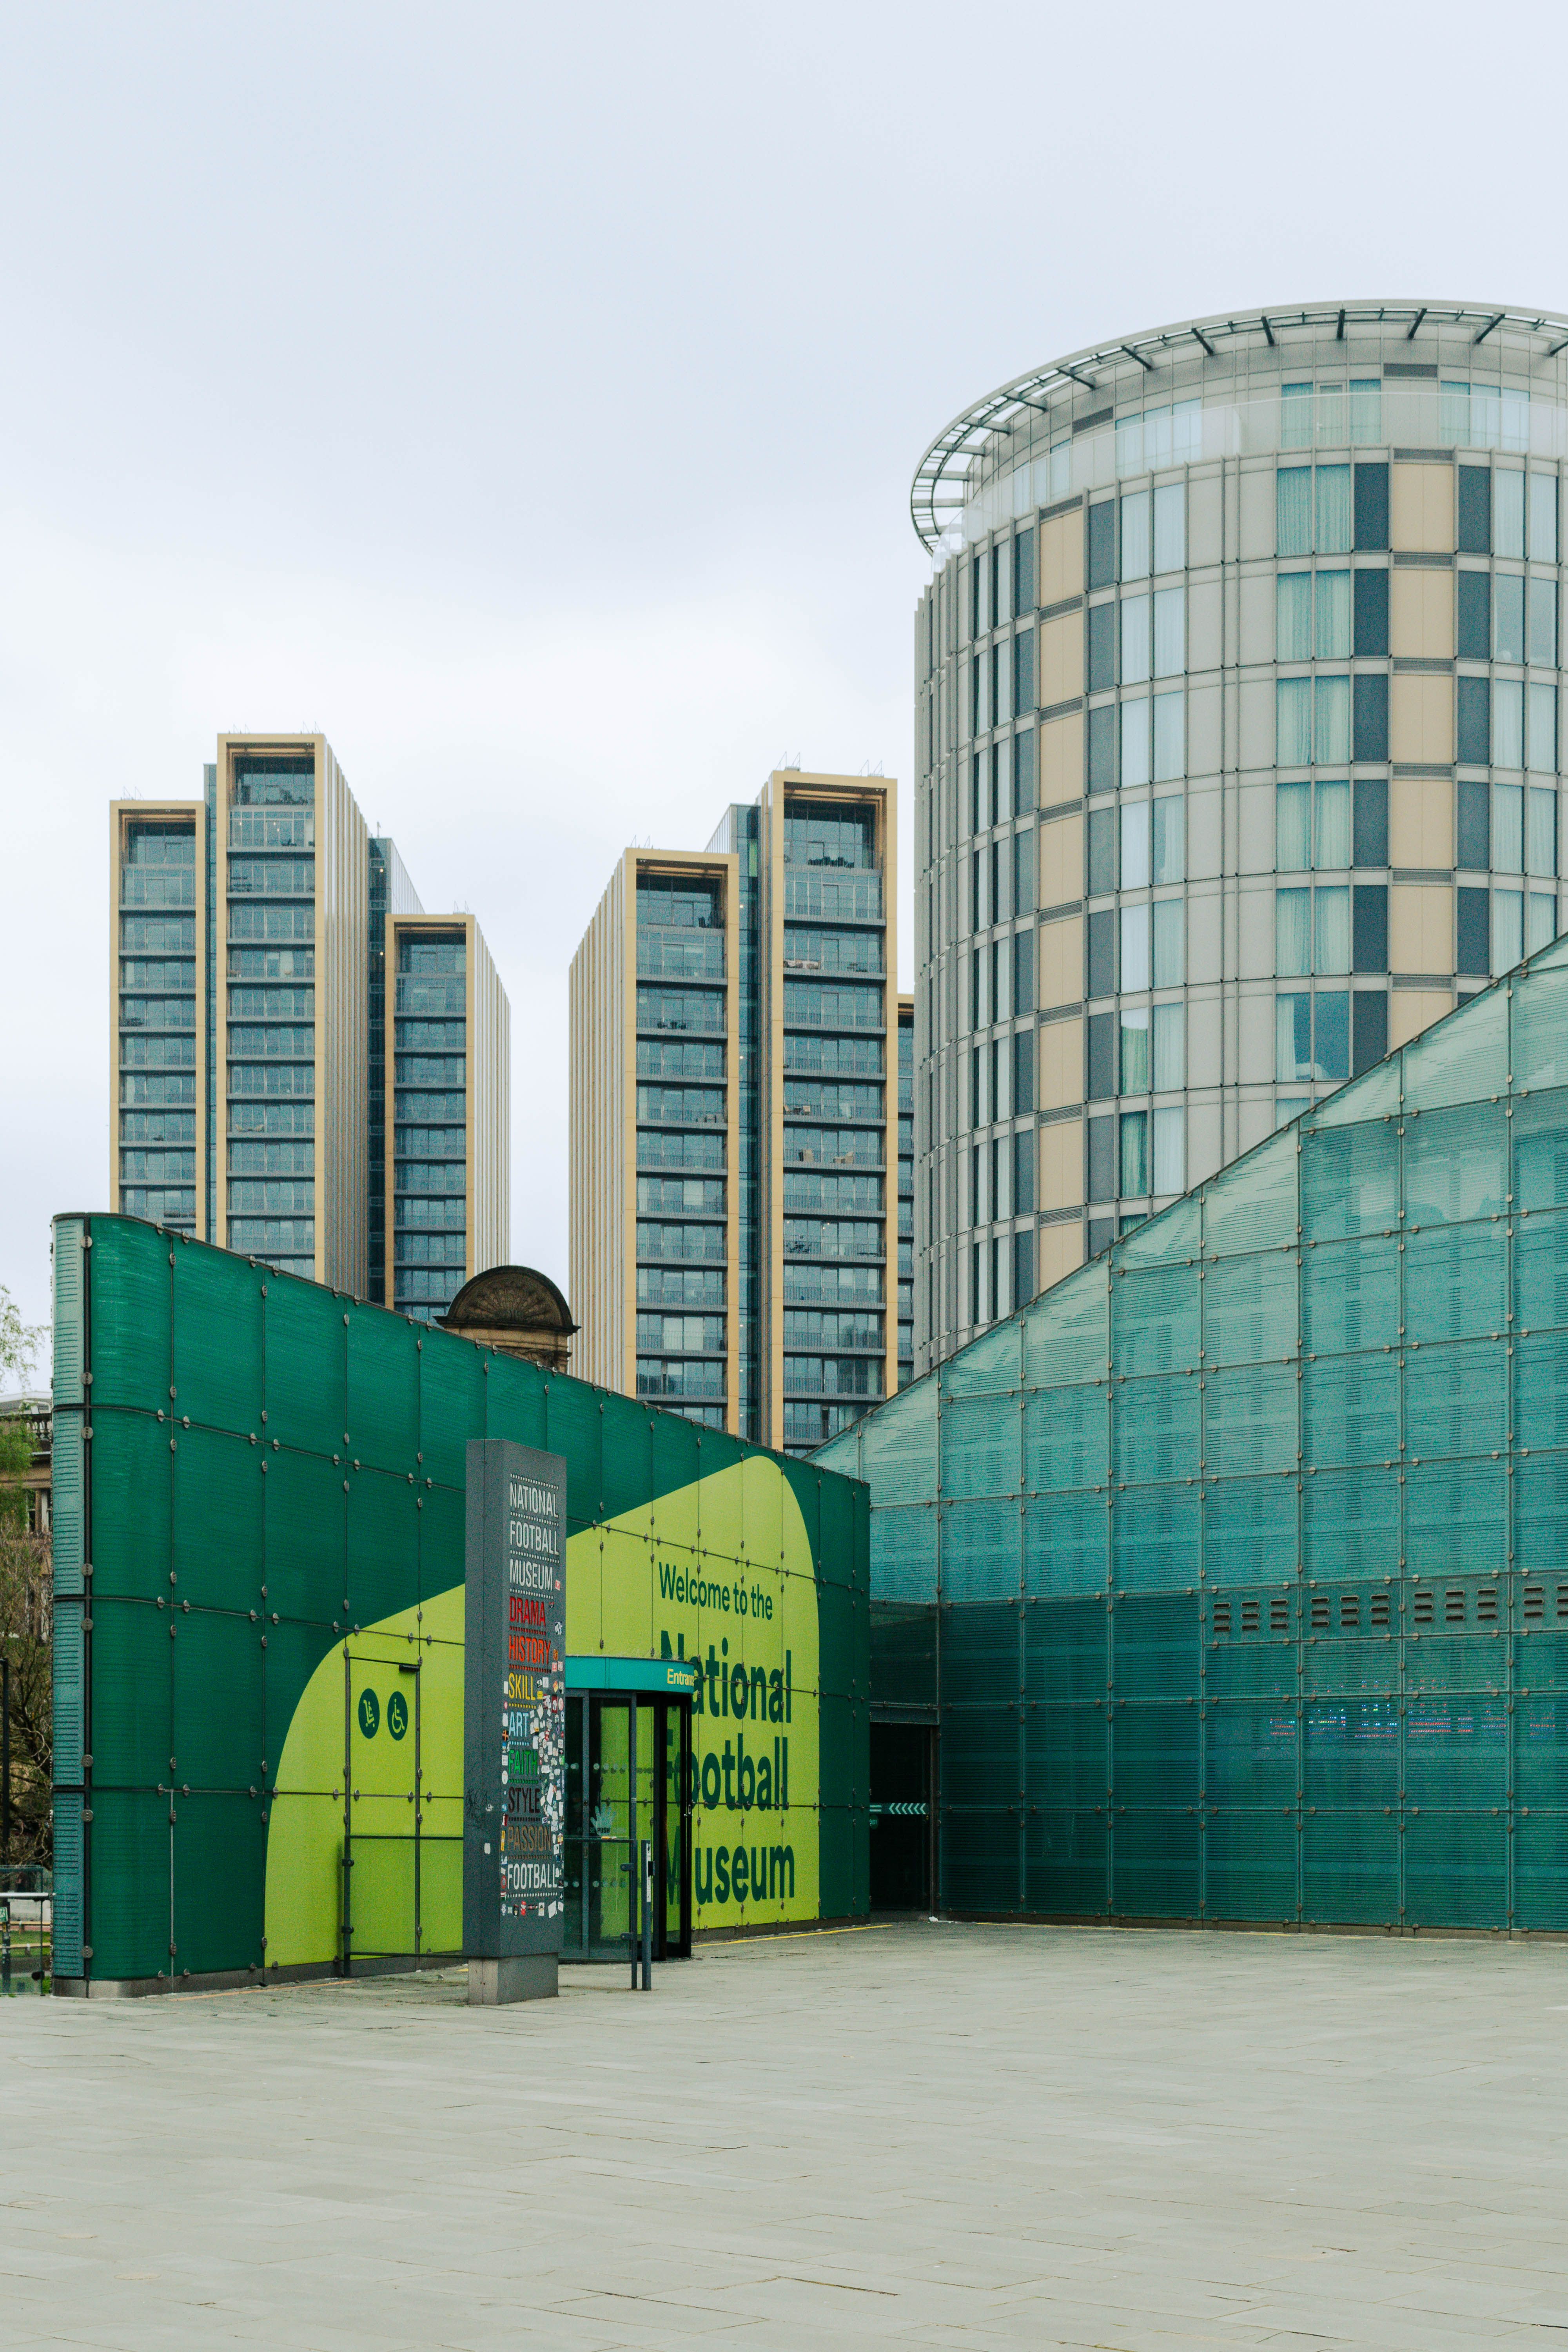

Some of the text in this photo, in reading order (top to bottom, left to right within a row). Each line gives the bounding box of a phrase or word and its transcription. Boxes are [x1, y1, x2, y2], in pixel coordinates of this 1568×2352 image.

[510, 1482, 558, 1518] NATIONAL
[510, 1520, 559, 1555] FOOTBALL
[510, 1558, 553, 1591] MUSEUM
[659, 1562, 772, 1620] Welcome to the
[510, 1596, 546, 1627] DRAMA
[509, 1635, 551, 1665] HISTORY
[508, 1672, 536, 1700] SKILL
[667, 1668, 694, 1687] Entranc
[508, 1711, 529, 1737] ART
[508, 1749, 538, 1775] FAITH
[508, 1786, 540, 1813] STYLE
[508, 1825, 552, 1852] PASSION
[508, 1863, 557, 1890] FOOTBALL
